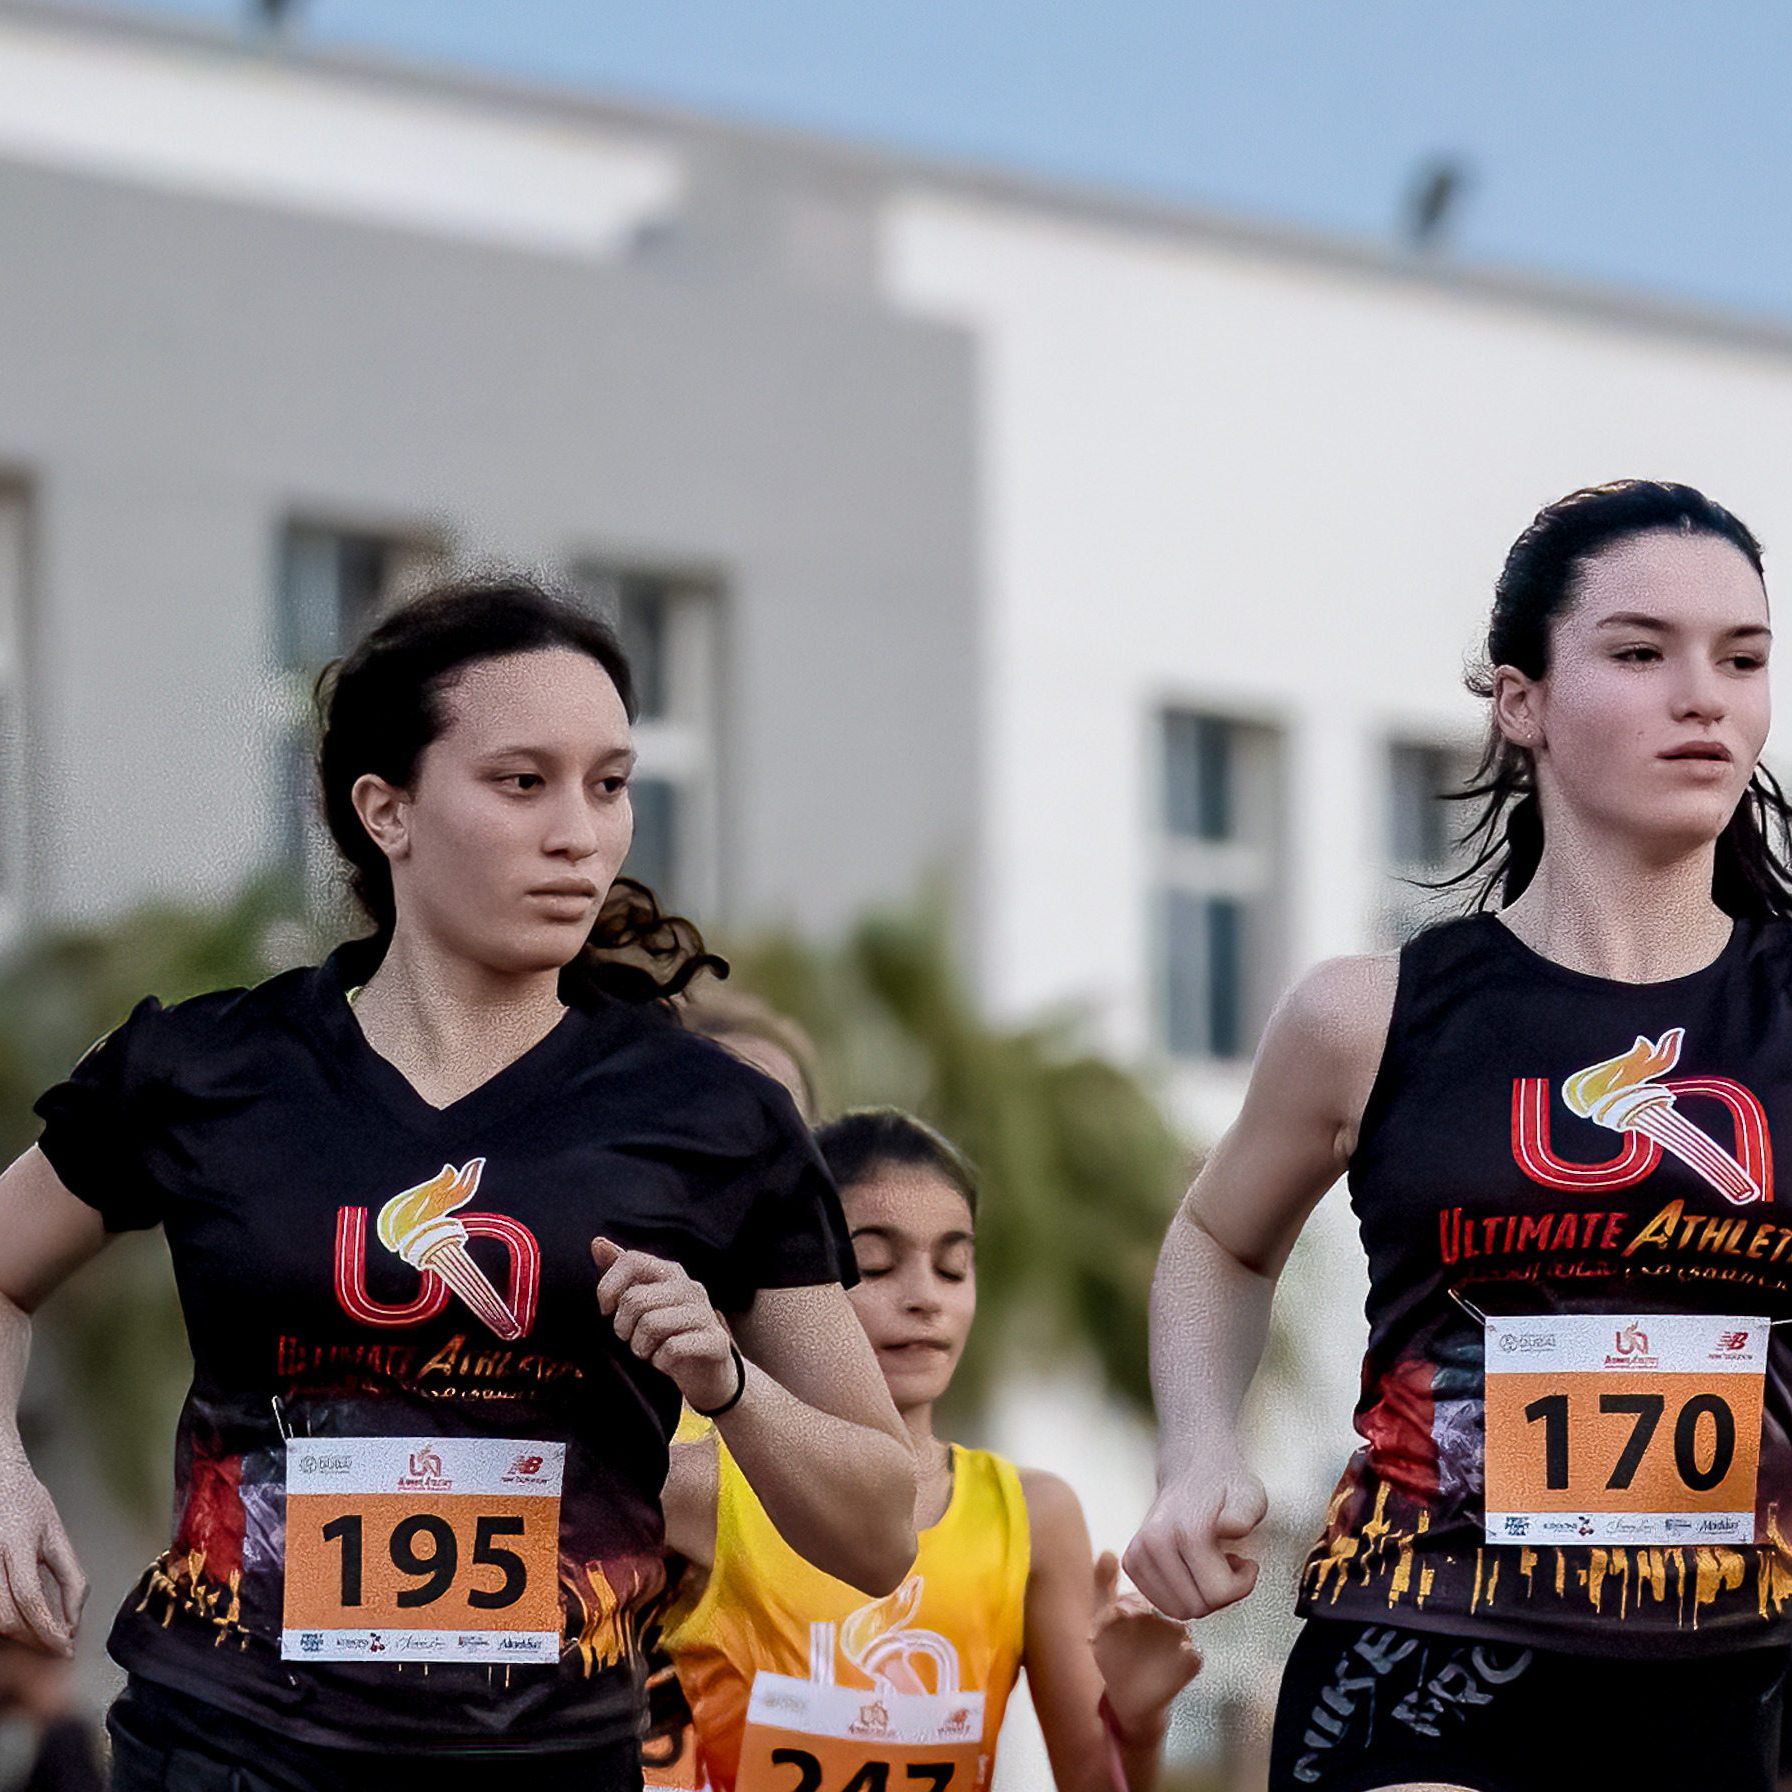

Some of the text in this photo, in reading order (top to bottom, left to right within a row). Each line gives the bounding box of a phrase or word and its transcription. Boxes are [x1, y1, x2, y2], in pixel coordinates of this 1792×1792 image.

[1440, 1207, 1628, 1265] ULTIMATE
[1524, 1392, 1736, 1492] 170
[321, 1513, 528, 1610] 195
